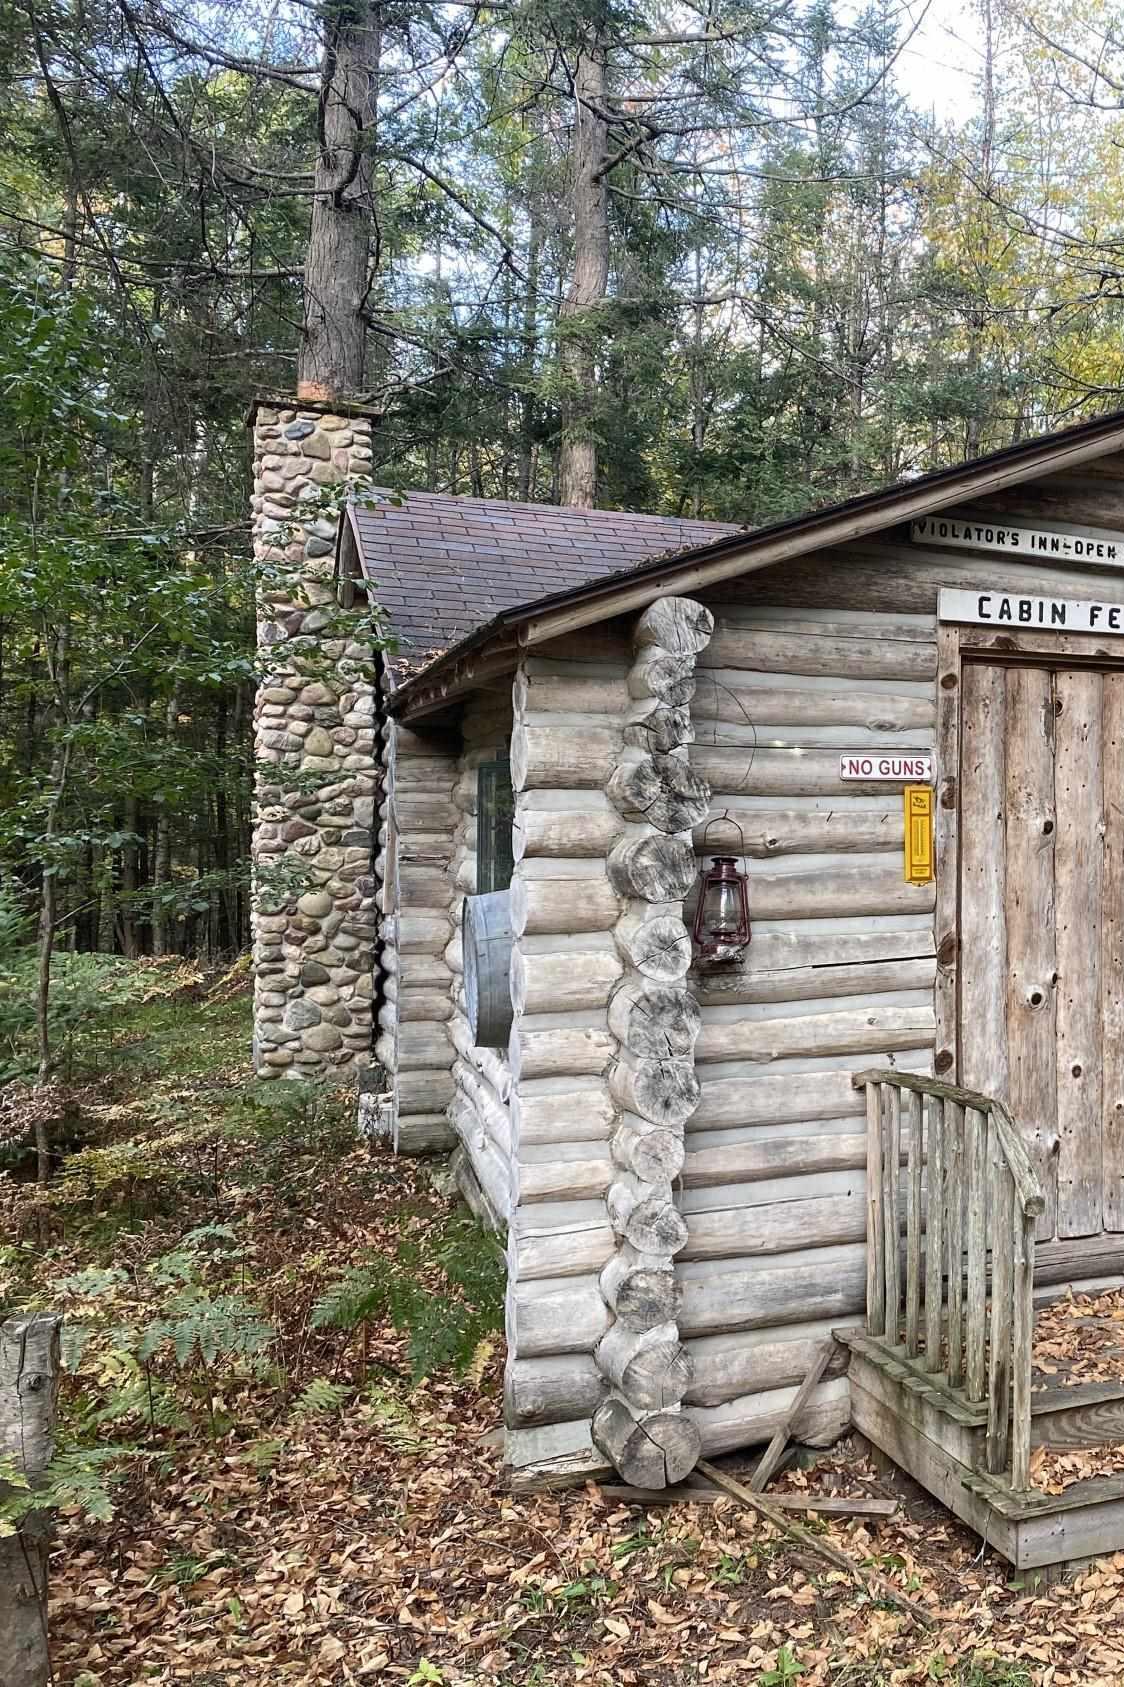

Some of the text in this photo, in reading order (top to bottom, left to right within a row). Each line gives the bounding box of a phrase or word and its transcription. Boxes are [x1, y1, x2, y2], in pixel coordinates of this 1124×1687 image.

[917, 520, 1019, 547] VIOLATOR'S
[978, 596, 1067, 625] CABIN
[849, 760, 924, 775] NO GUNS
